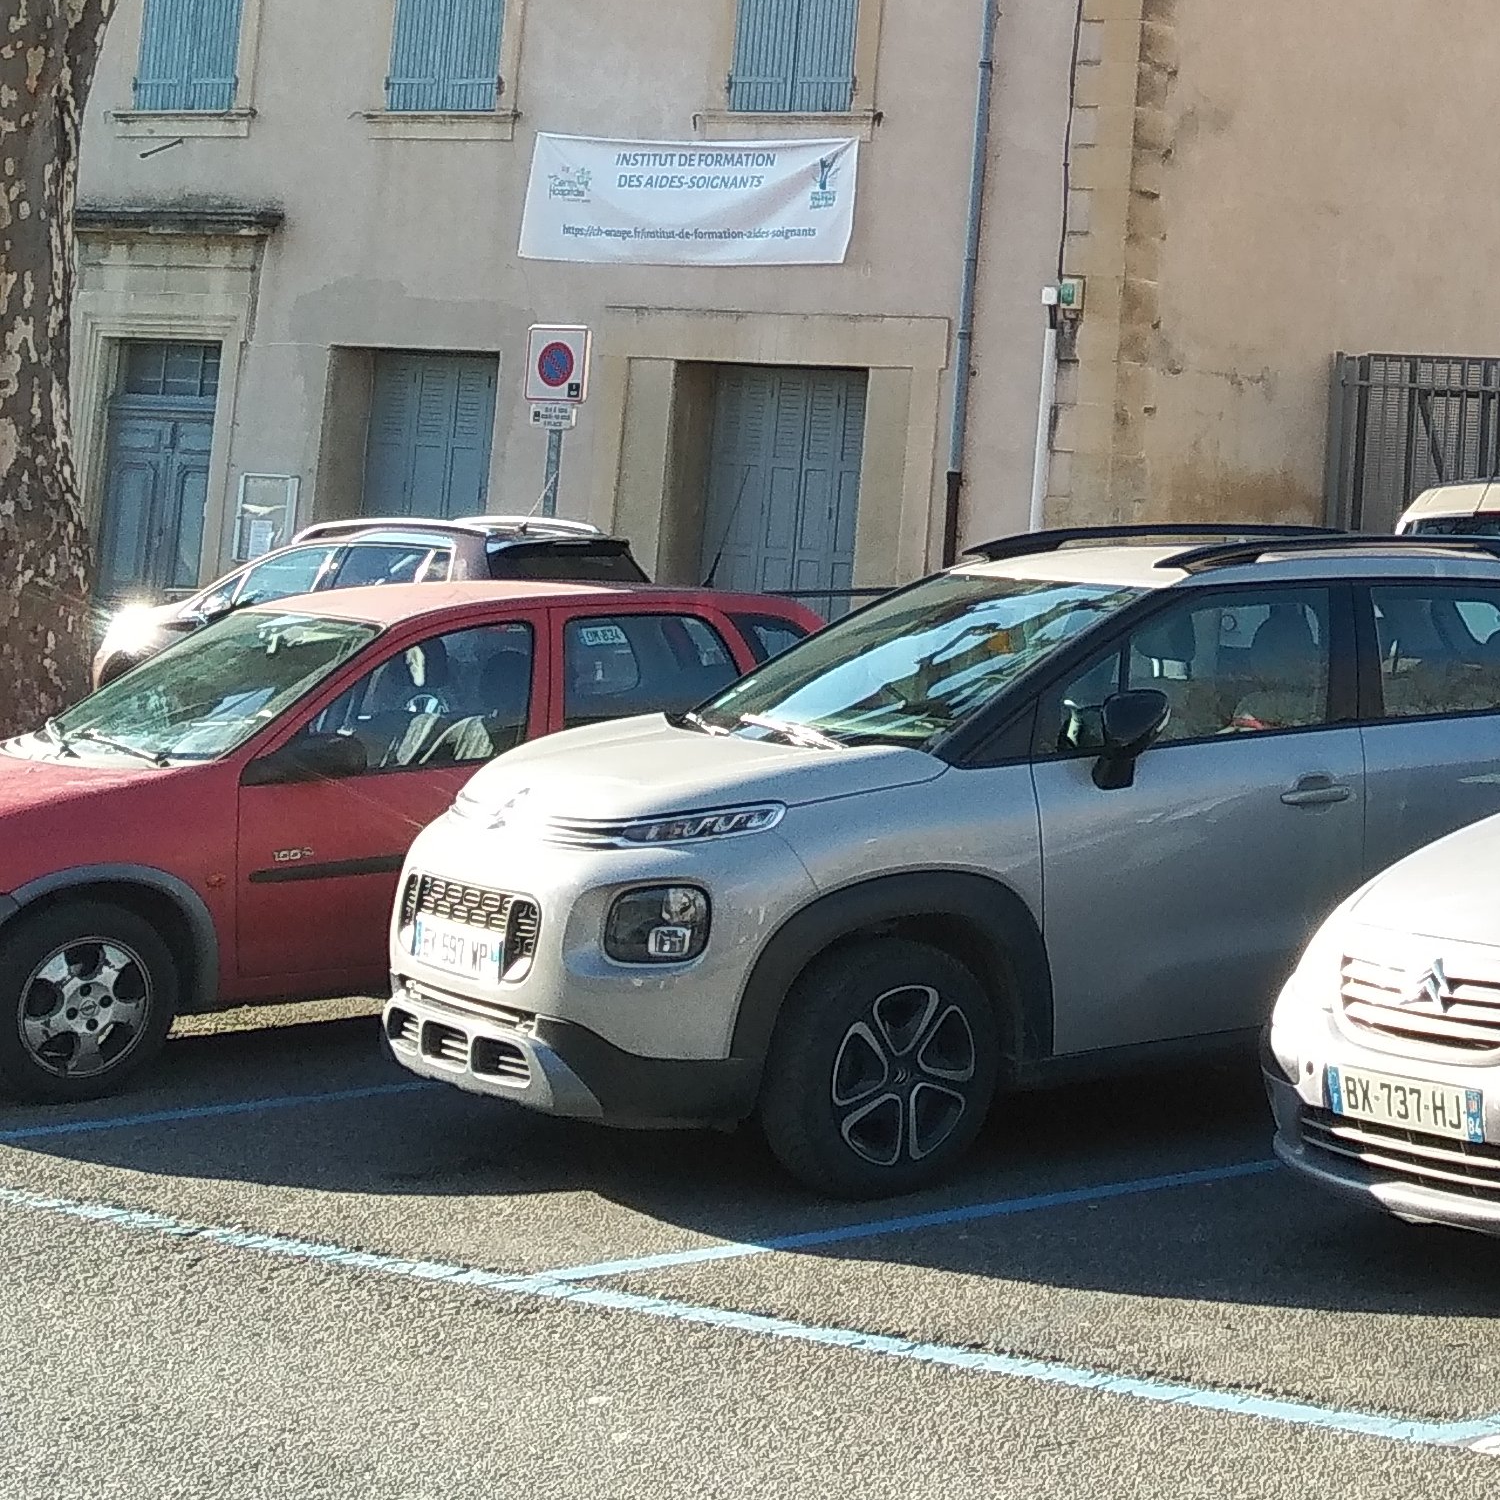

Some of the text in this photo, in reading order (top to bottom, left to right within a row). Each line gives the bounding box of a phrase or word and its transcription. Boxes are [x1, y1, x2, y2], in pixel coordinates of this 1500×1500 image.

[615, 152, 776, 167] INSTITUT DE FORMATION
[617, 174, 764, 189] DES AIDES-SOIGNANTS
[1344, 1075, 1463, 1130] BX-737-HJ
